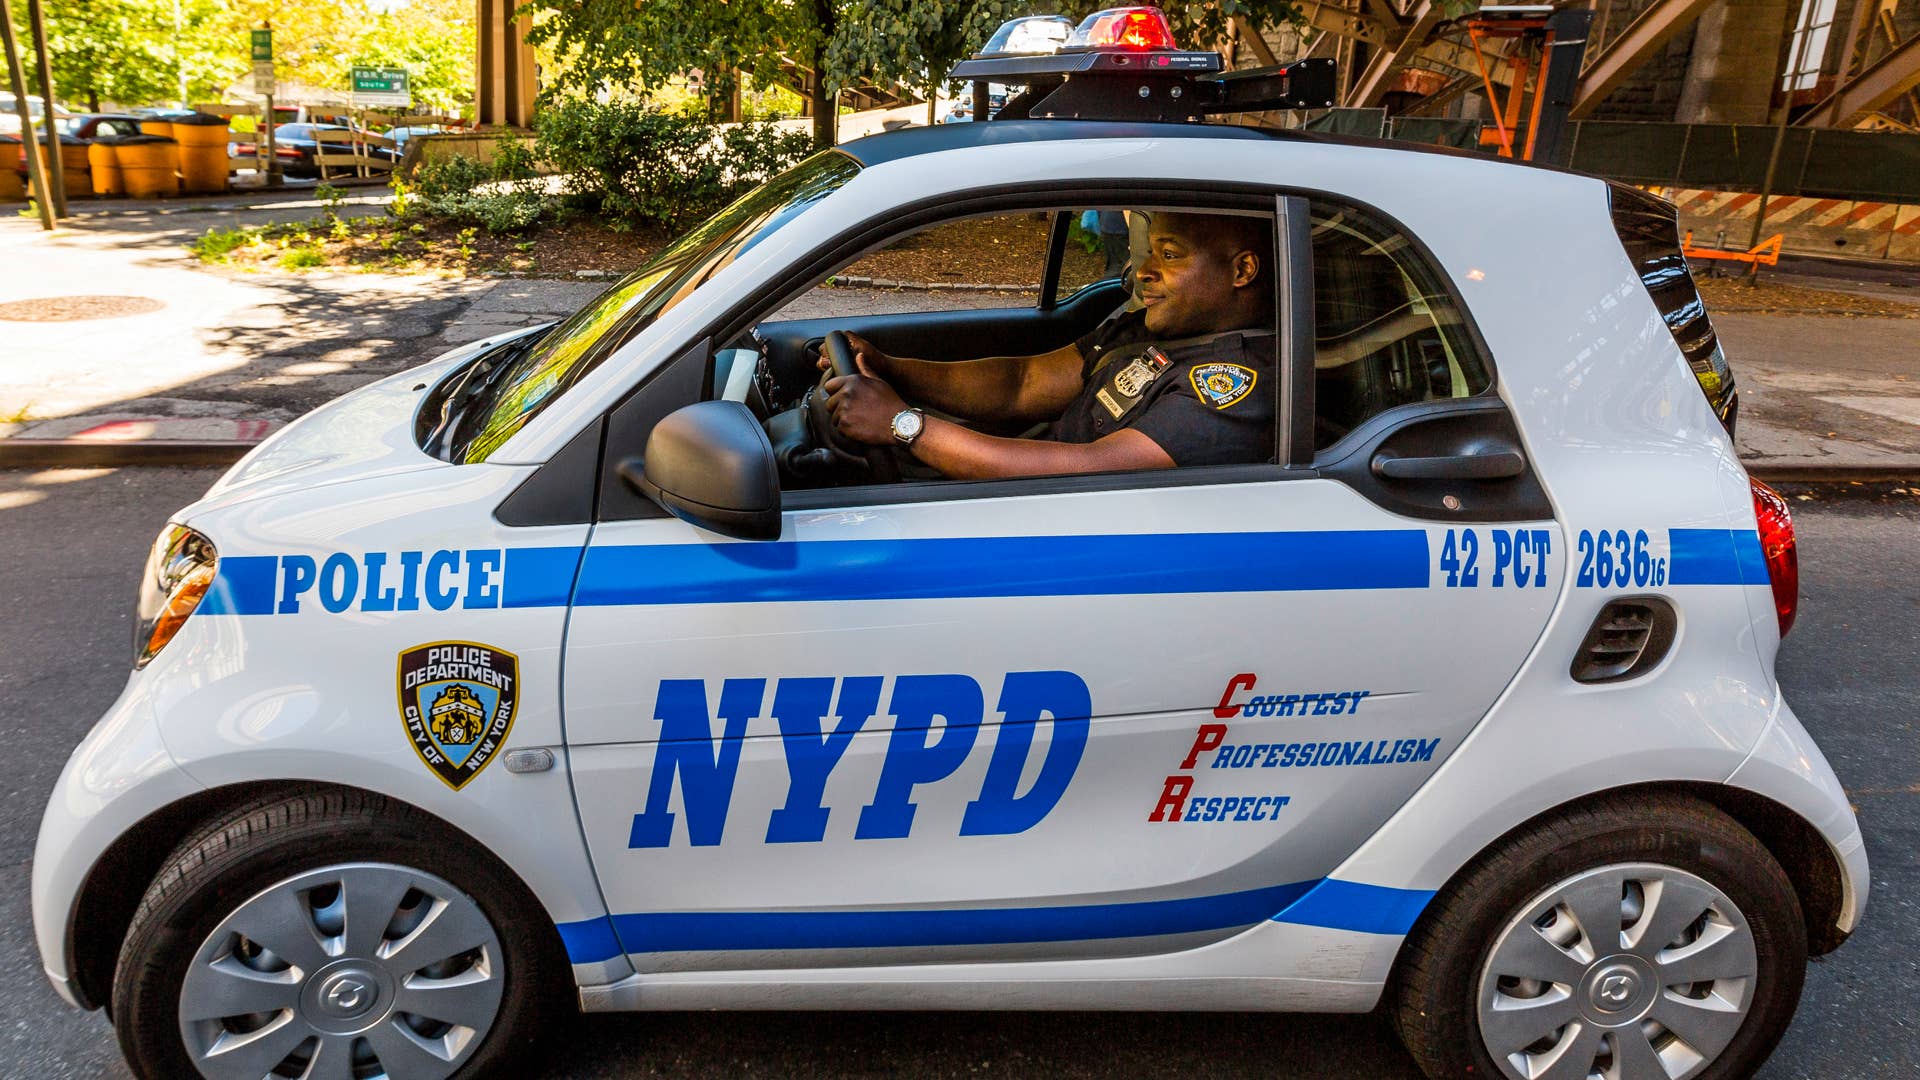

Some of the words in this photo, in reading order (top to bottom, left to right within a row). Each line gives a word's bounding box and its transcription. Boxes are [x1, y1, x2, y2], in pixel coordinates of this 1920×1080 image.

[1217, 395, 1234, 405] NEW
[1232, 384, 1249, 397] YORK
[278, 549, 501, 614] POLICE
[1440, 528, 1479, 588] 42
[1491, 528, 1551, 588] PCT
[1576, 529, 1649, 589] 2636
[1650, 557, 1665, 587] 16
[405, 663, 512, 691] DEPARTMENT
[428, 646, 491, 667] POLICE
[1213, 673, 1370, 718] COURTESY
[405, 705, 428, 743] CITY
[422, 745, 444, 764] OF
[465, 739, 496, 771] NEW
[491, 700, 512, 736] YORK
[627, 670, 1092, 849] NYPD
[1179, 724, 1440, 769] PROFESSIONALISM
[1148, 775, 1291, 822] RESPECT
